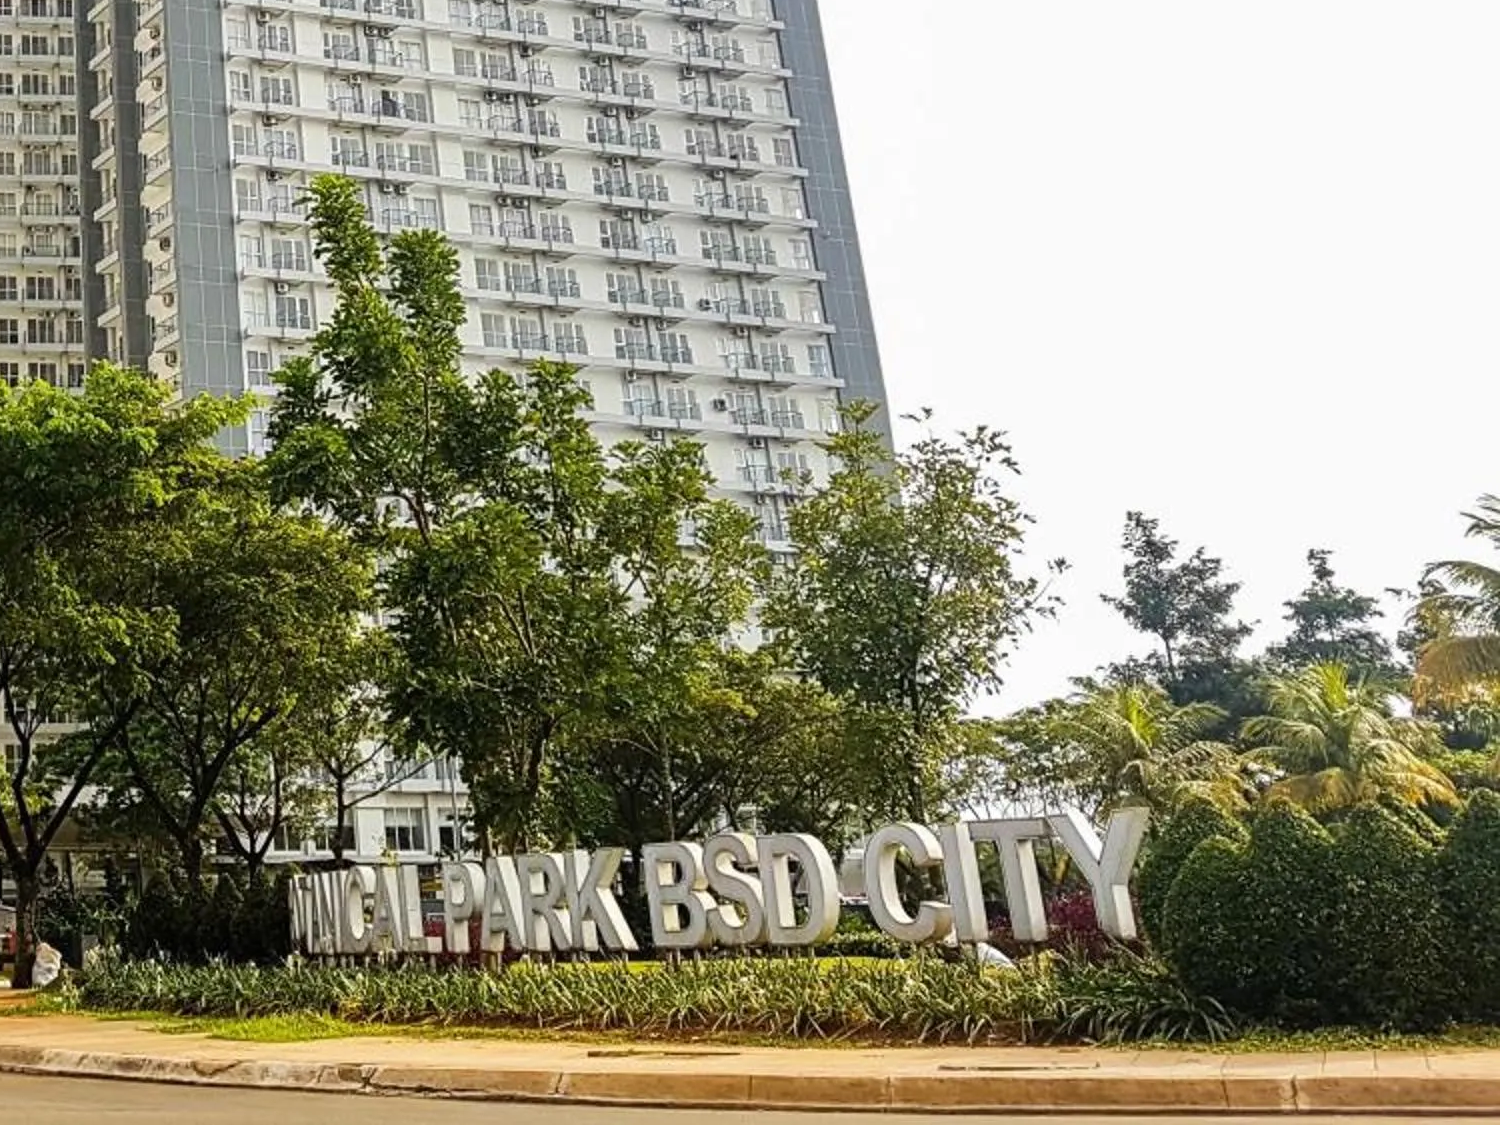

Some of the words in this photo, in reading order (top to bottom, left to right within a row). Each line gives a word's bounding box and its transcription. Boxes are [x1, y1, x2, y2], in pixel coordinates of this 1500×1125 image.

[442, 846, 640, 954] PARK
[642, 831, 840, 948] BSD
[864, 806, 1151, 944] CITY
